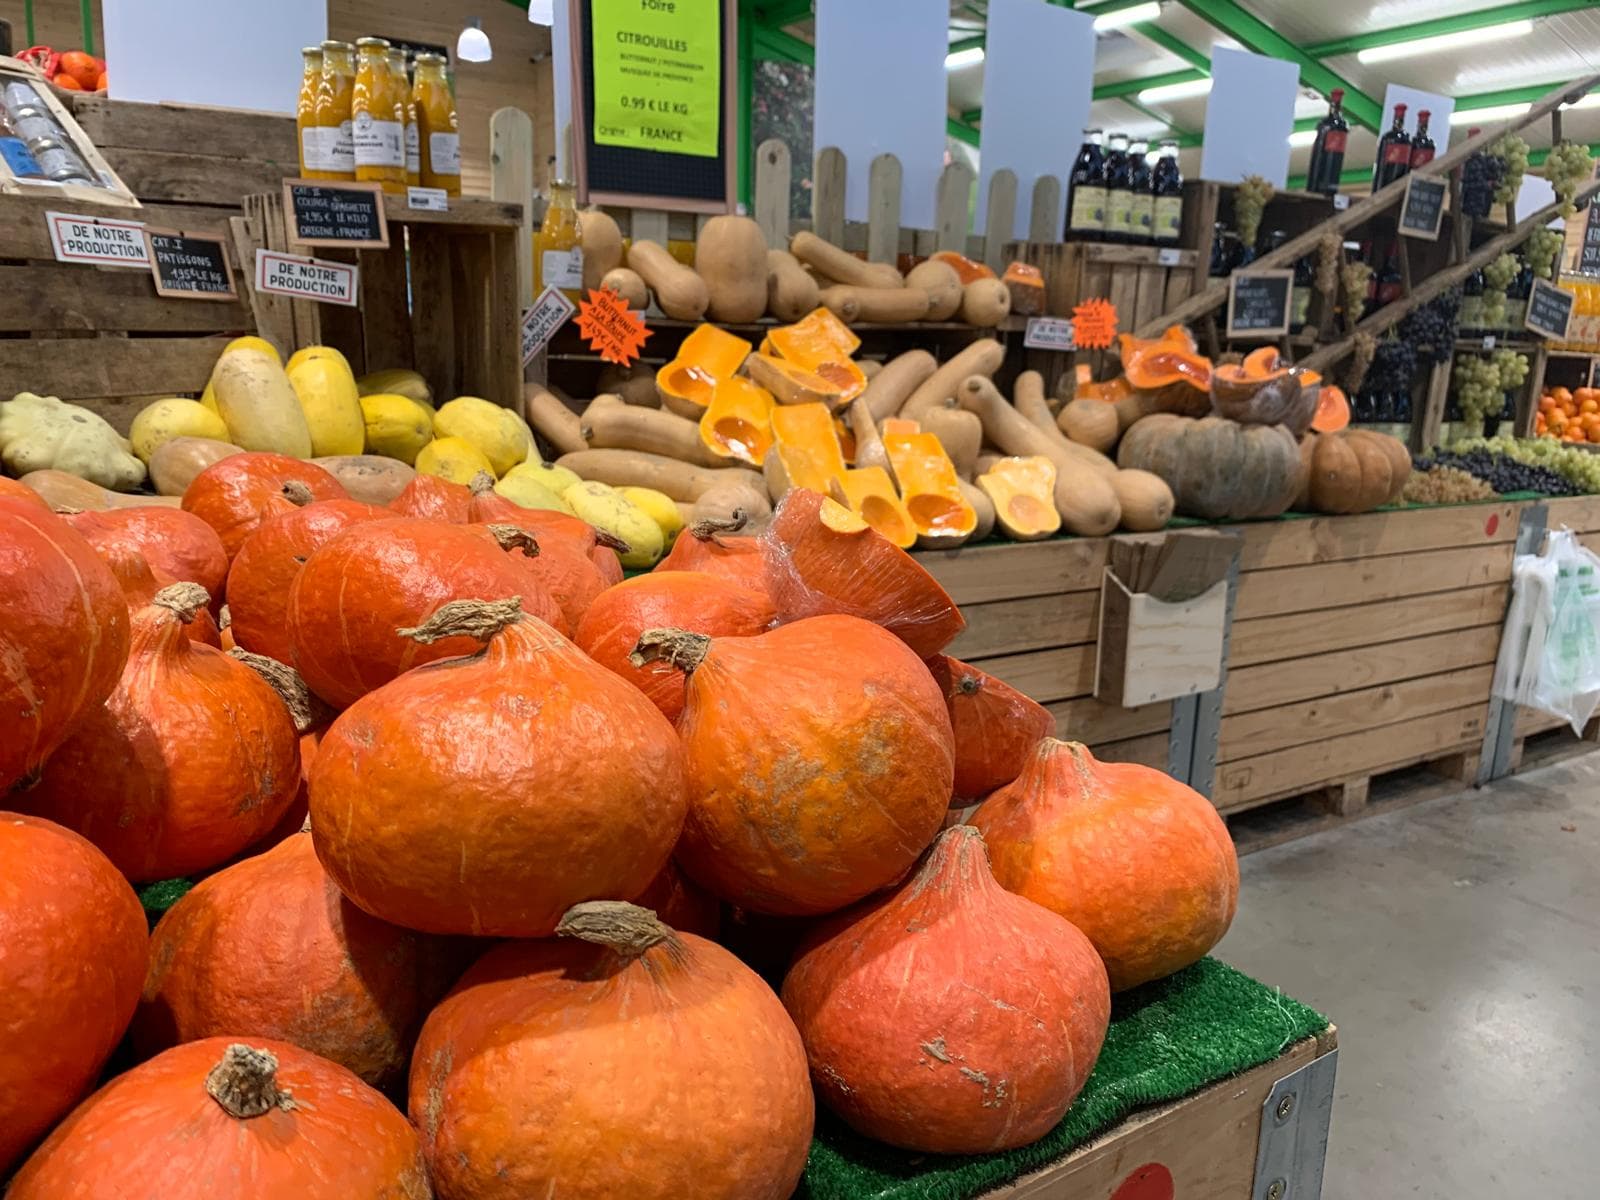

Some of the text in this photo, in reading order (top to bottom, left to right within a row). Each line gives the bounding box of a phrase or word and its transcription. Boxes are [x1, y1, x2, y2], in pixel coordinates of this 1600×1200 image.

[616, 31, 688, 52] CITROUILLES
[621, 96, 689, 115] 0.99 € LE KG
[640, 126, 684, 142] FRANCE
[72, 224, 133, 242] DE NOTRE
[68, 239, 145, 258] PRODUCTION
[157, 252, 212, 267] PATISSONS
[279, 262, 338, 282] DE NOTRE
[270, 274, 345, 297] PRODUCTION
[526, 302, 552, 332] NOTRE
[598, 297, 637, 336] BUTTERNUT
